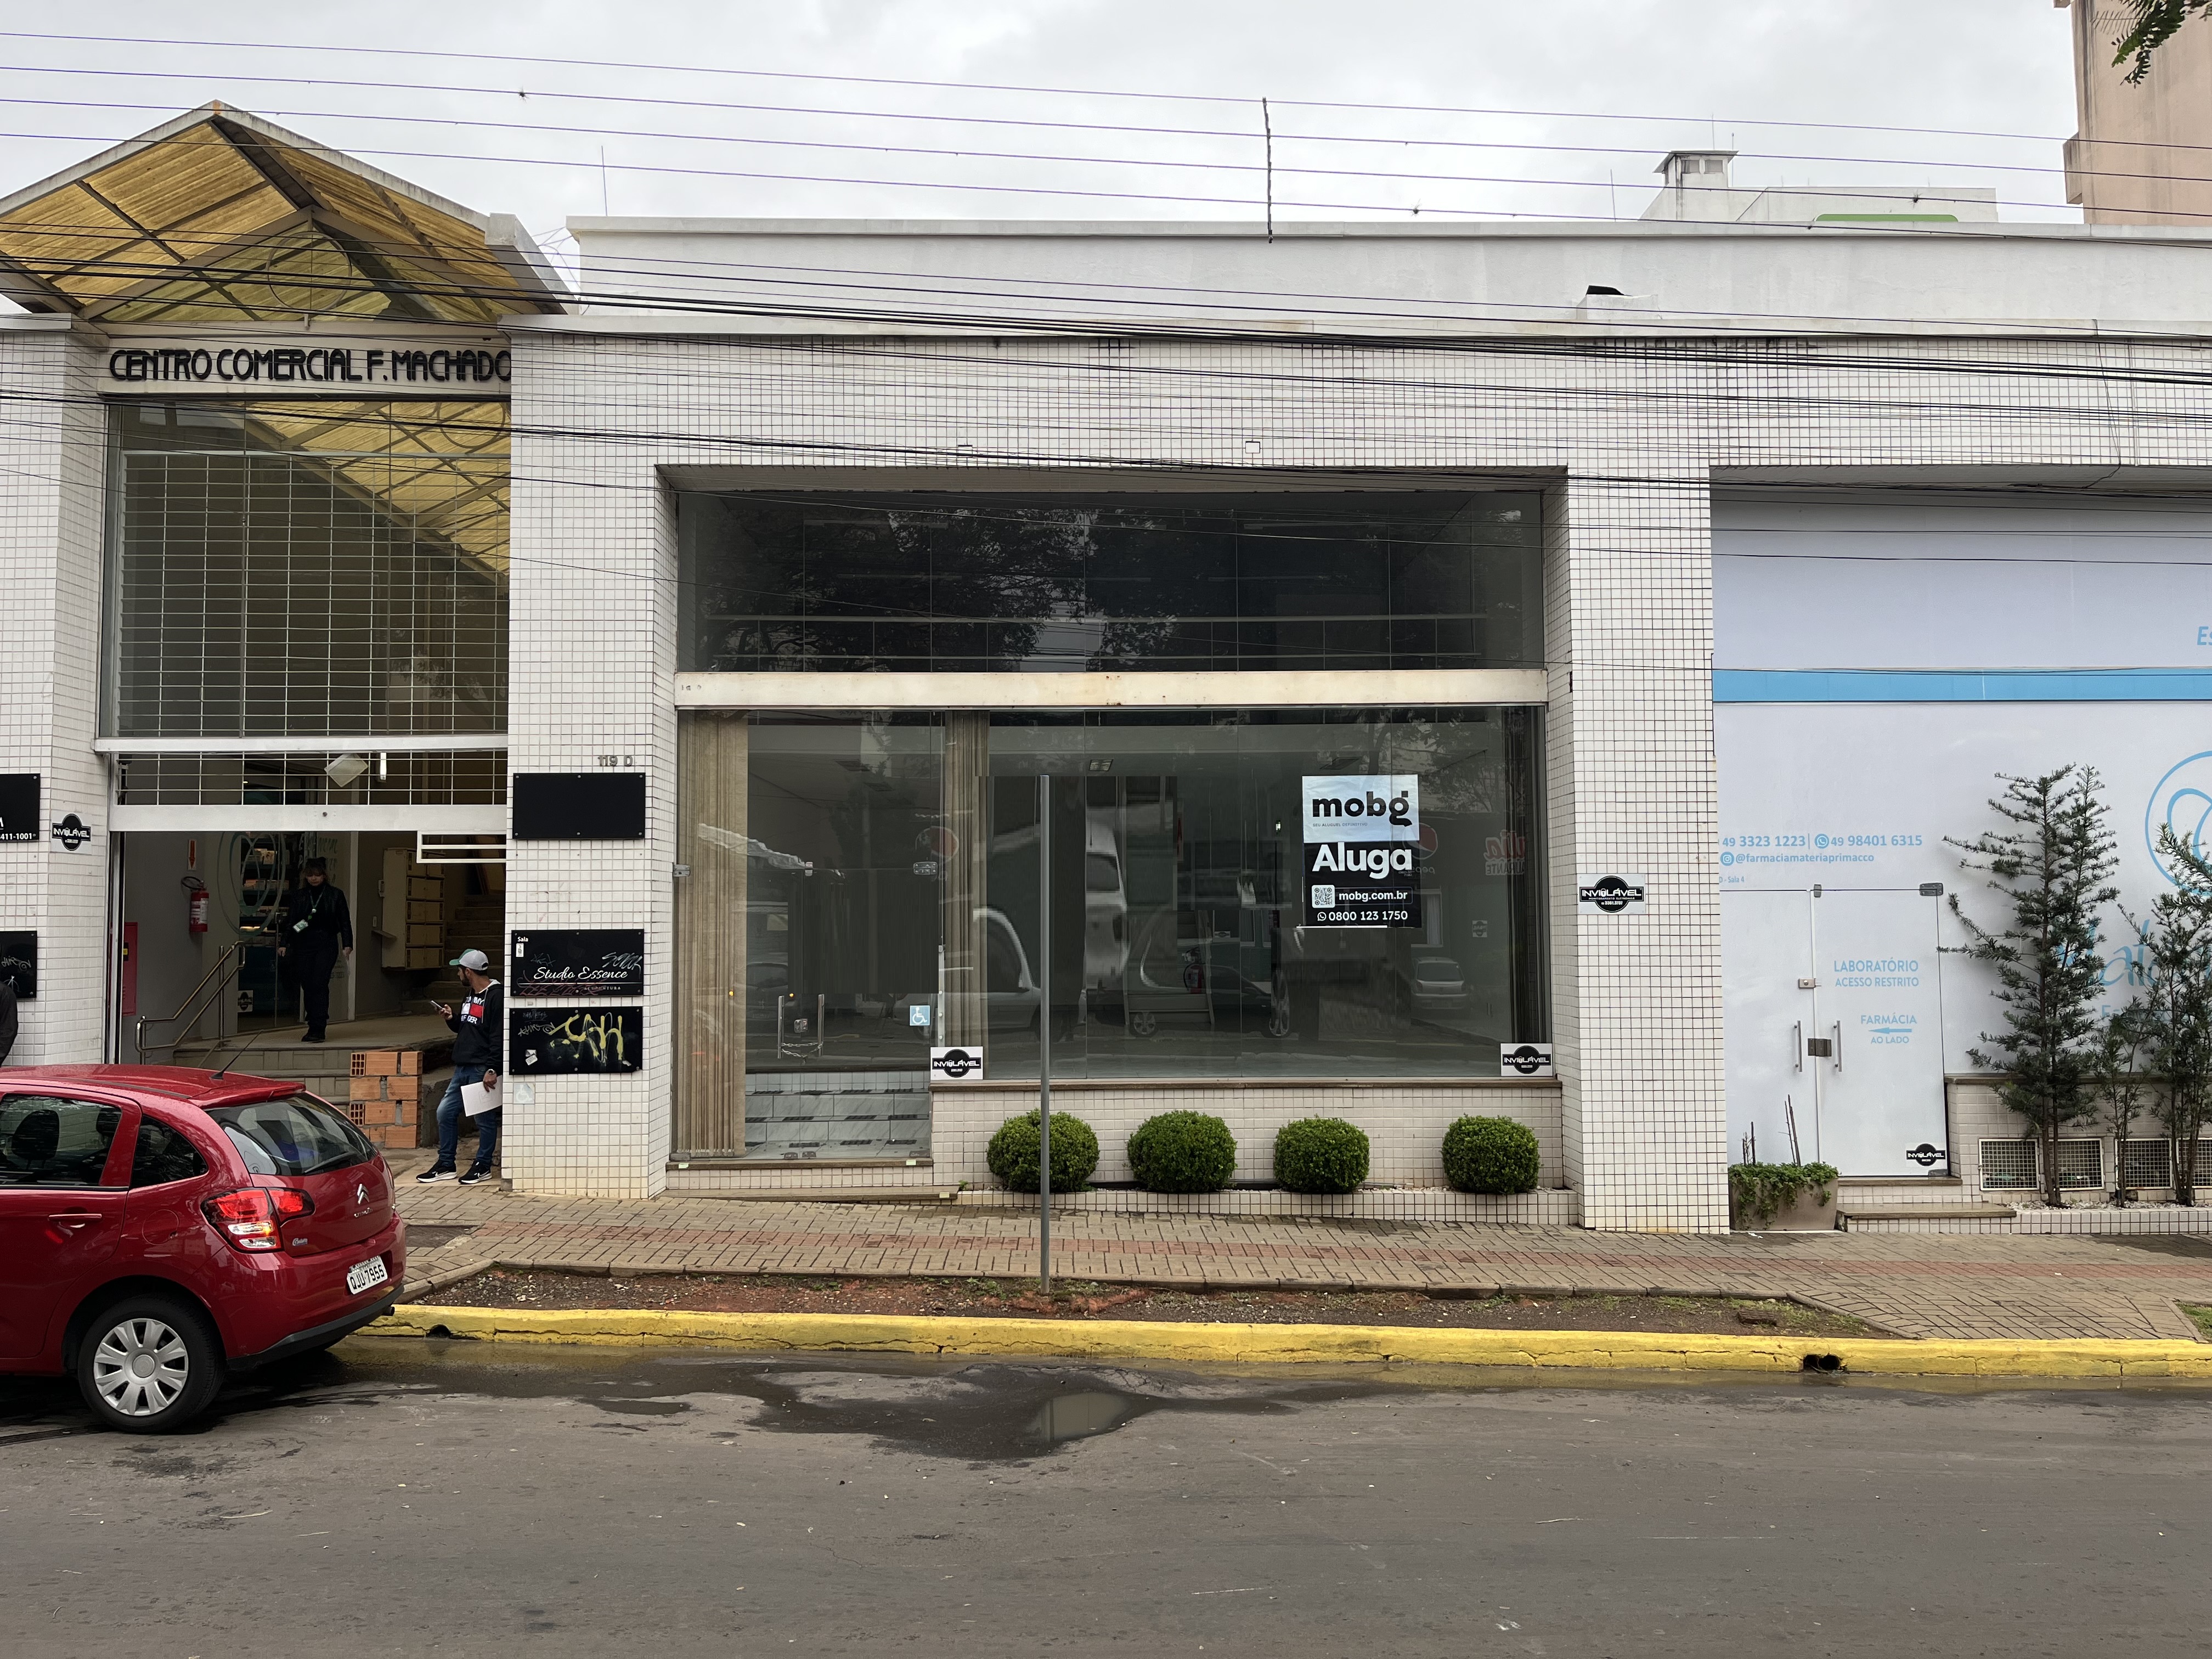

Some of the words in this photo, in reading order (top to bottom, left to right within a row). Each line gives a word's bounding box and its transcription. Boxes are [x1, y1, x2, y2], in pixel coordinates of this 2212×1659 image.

[110, 348, 212, 380] CENTRO
[217, 348, 363, 381] COMERCIAL
[367, 349, 388, 381] F.
[392, 349, 511, 381] MACHADO
[597, 755, 618, 766] 119
[623, 755, 633, 766] D
[1312, 790, 1413, 827] mobg
[1722, 837, 1736, 847] 49
[1740, 836, 1771, 847] 3323
[1775, 836, 1805, 847] 1223
[1831, 837, 1844, 847] 49
[1848, 835, 1887, 846] 98401
[1891, 835, 1923, 846] 6315
[1312, 842, 1412, 879] Aluga
[1735, 853, 1875, 864] @farmaciamateriaprimacco
[1339, 890, 1408, 902] mobg.com.br
[1582, 888, 1641, 897] INVIOLÁVEL
[1329, 911, 1357, 921] 0800
[1361, 911, 1379, 921] 123
[1382, 911, 1408, 920] 1750
[1834, 957, 1918, 972] LABORATÓRIO
[533, 966, 575, 980] Studio
[578, 966, 628, 980] Essence
[1835, 977, 1872, 986] ACESSO
[1875, 977, 1919, 986] RESTRITO
[1860, 1012, 1917, 1024] FARMÁCIA
